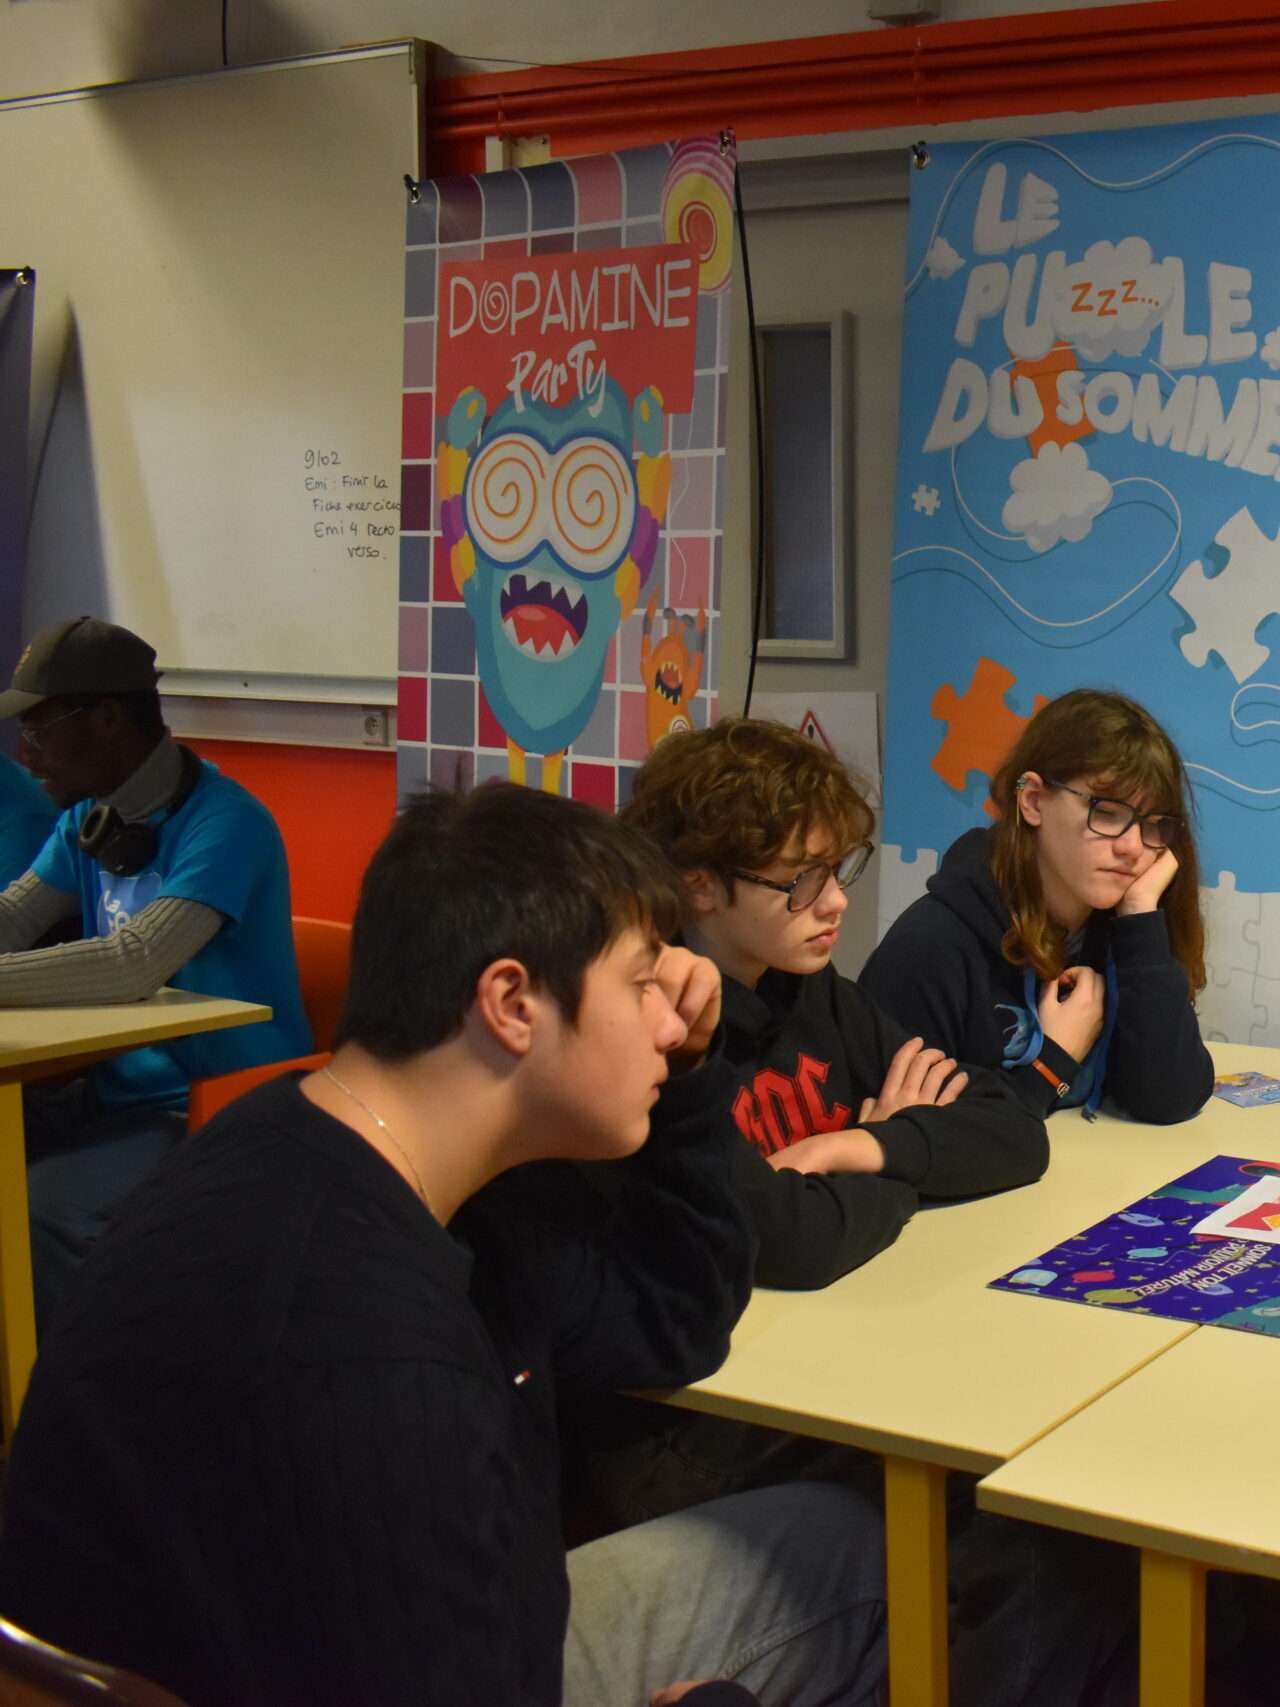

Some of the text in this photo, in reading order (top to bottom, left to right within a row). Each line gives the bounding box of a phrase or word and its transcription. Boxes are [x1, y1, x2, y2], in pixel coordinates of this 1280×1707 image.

[973, 162, 1060, 255] LE
[449, 257, 692, 337] DOPAMINE
[923, 358, 1043, 453] DU
[374, 475, 388, 488] la
[350, 522, 357, 536] 4
[1192, 1273, 1228, 1289] TON
